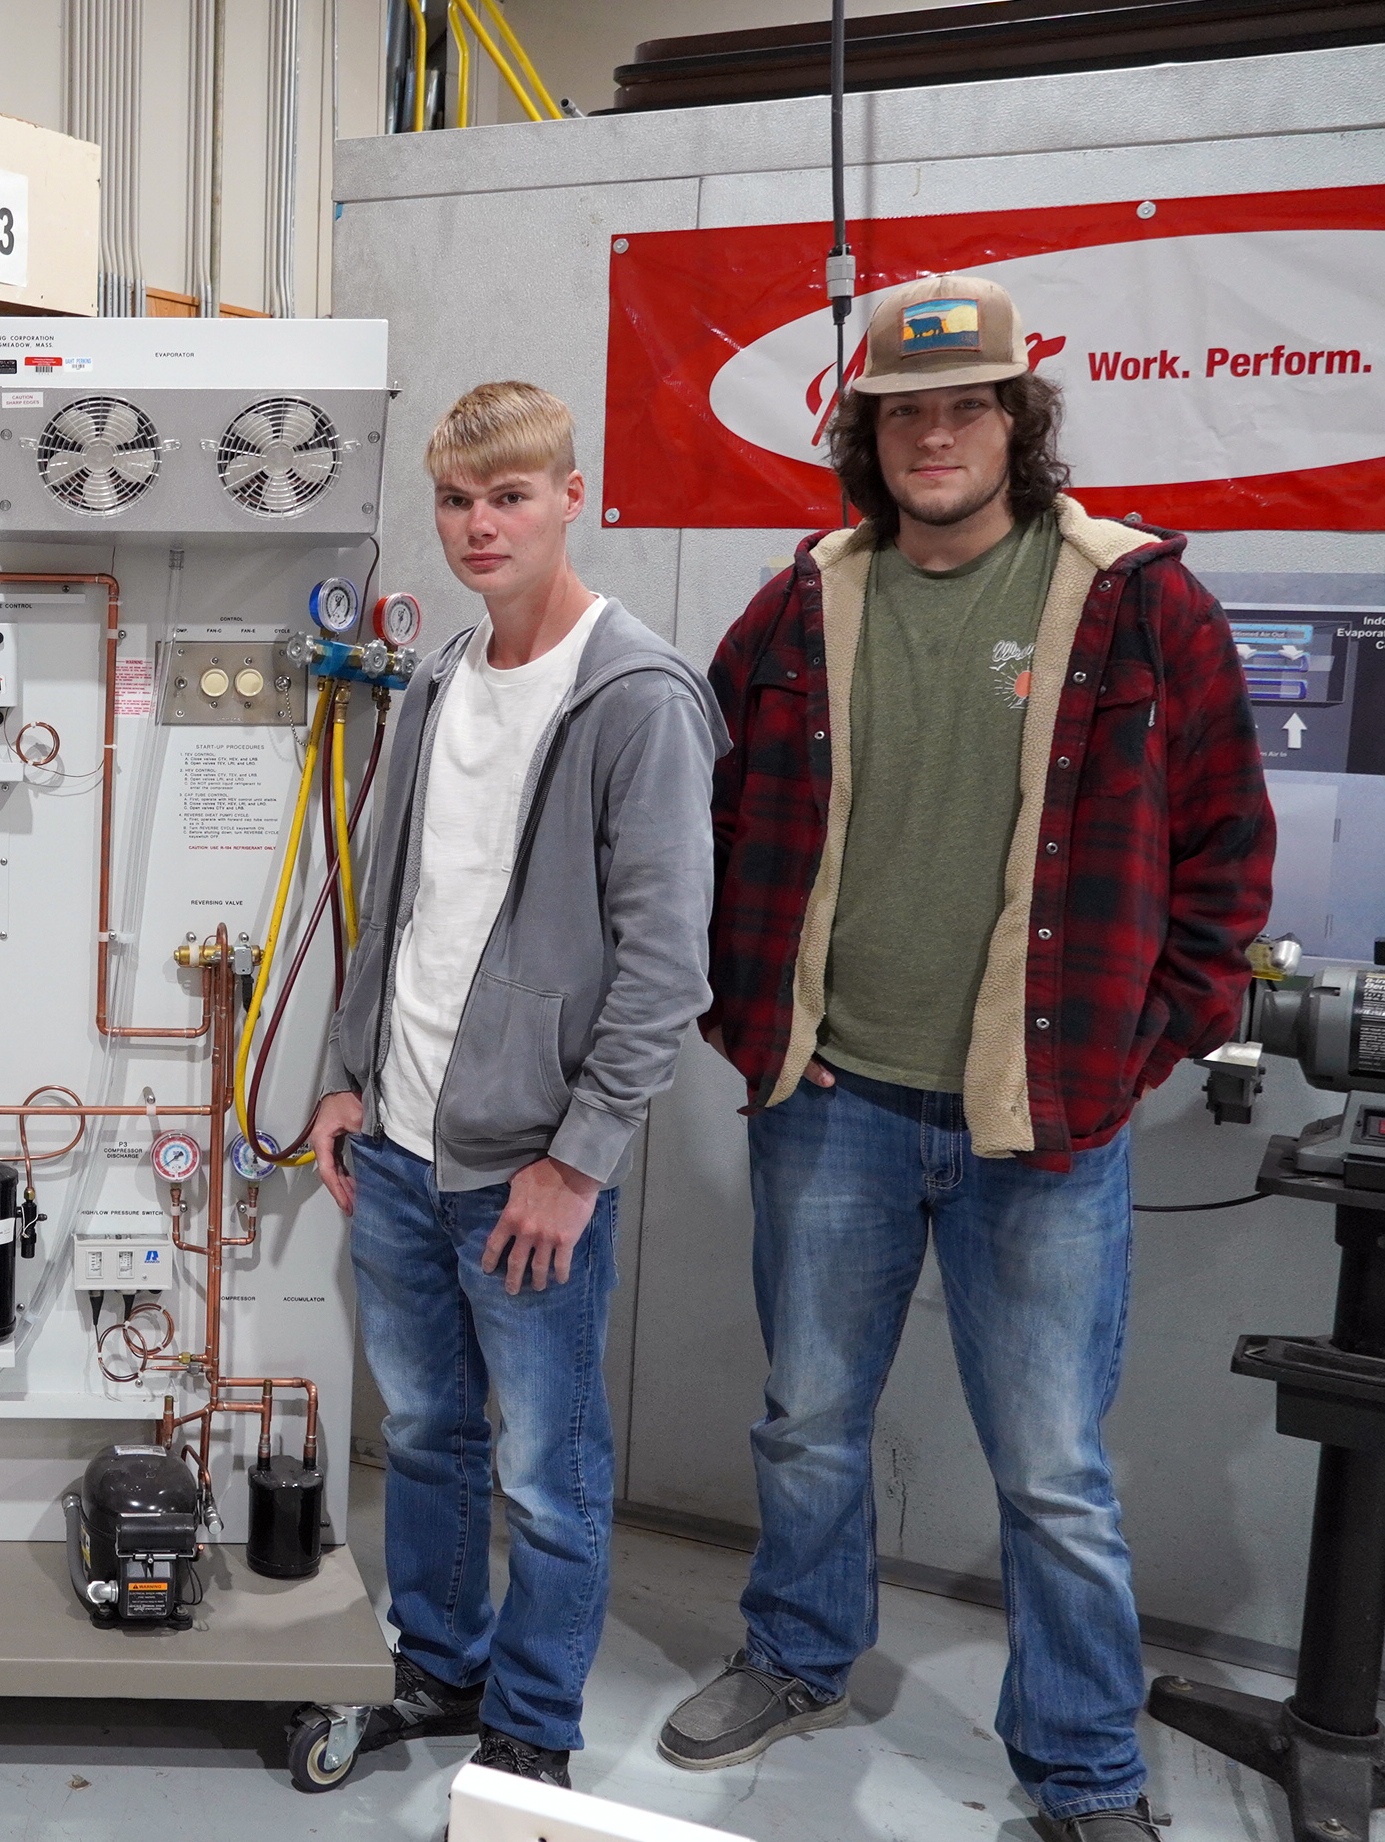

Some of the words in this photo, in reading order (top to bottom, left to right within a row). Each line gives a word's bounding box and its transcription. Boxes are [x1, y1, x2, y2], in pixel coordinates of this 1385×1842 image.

[1088, 350, 1189, 381] Work.
[1206, 345, 1371, 378] Perform.
[1337, 628, 1385, 638] Evapora
